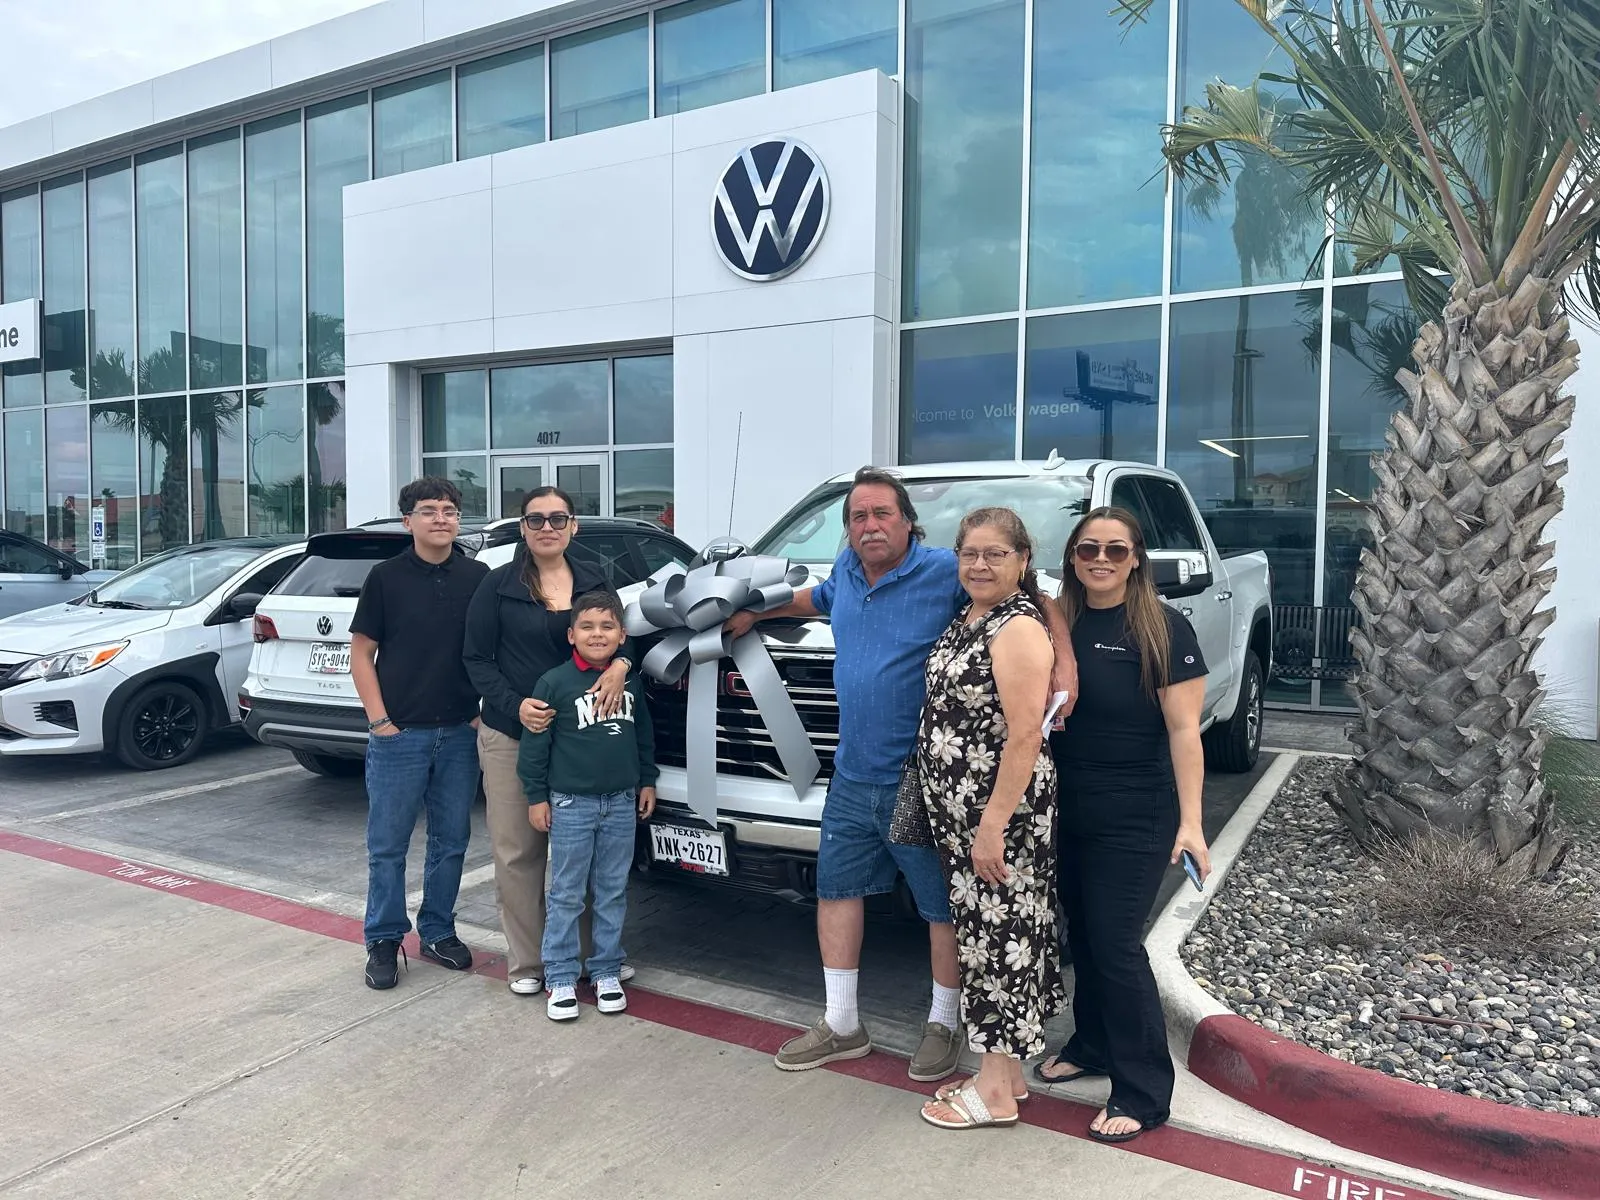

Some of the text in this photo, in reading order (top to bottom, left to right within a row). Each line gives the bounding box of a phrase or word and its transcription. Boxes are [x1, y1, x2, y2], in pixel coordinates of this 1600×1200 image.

[912, 401, 1080, 422] lcome to Volkwagen
[537, 431, 560, 445] 4017
[1094, 643, 1126, 652] Champion
[574, 690, 635, 730] NE
[672, 828, 701, 839] TEXAS
[108, 862, 153, 878] TOW
